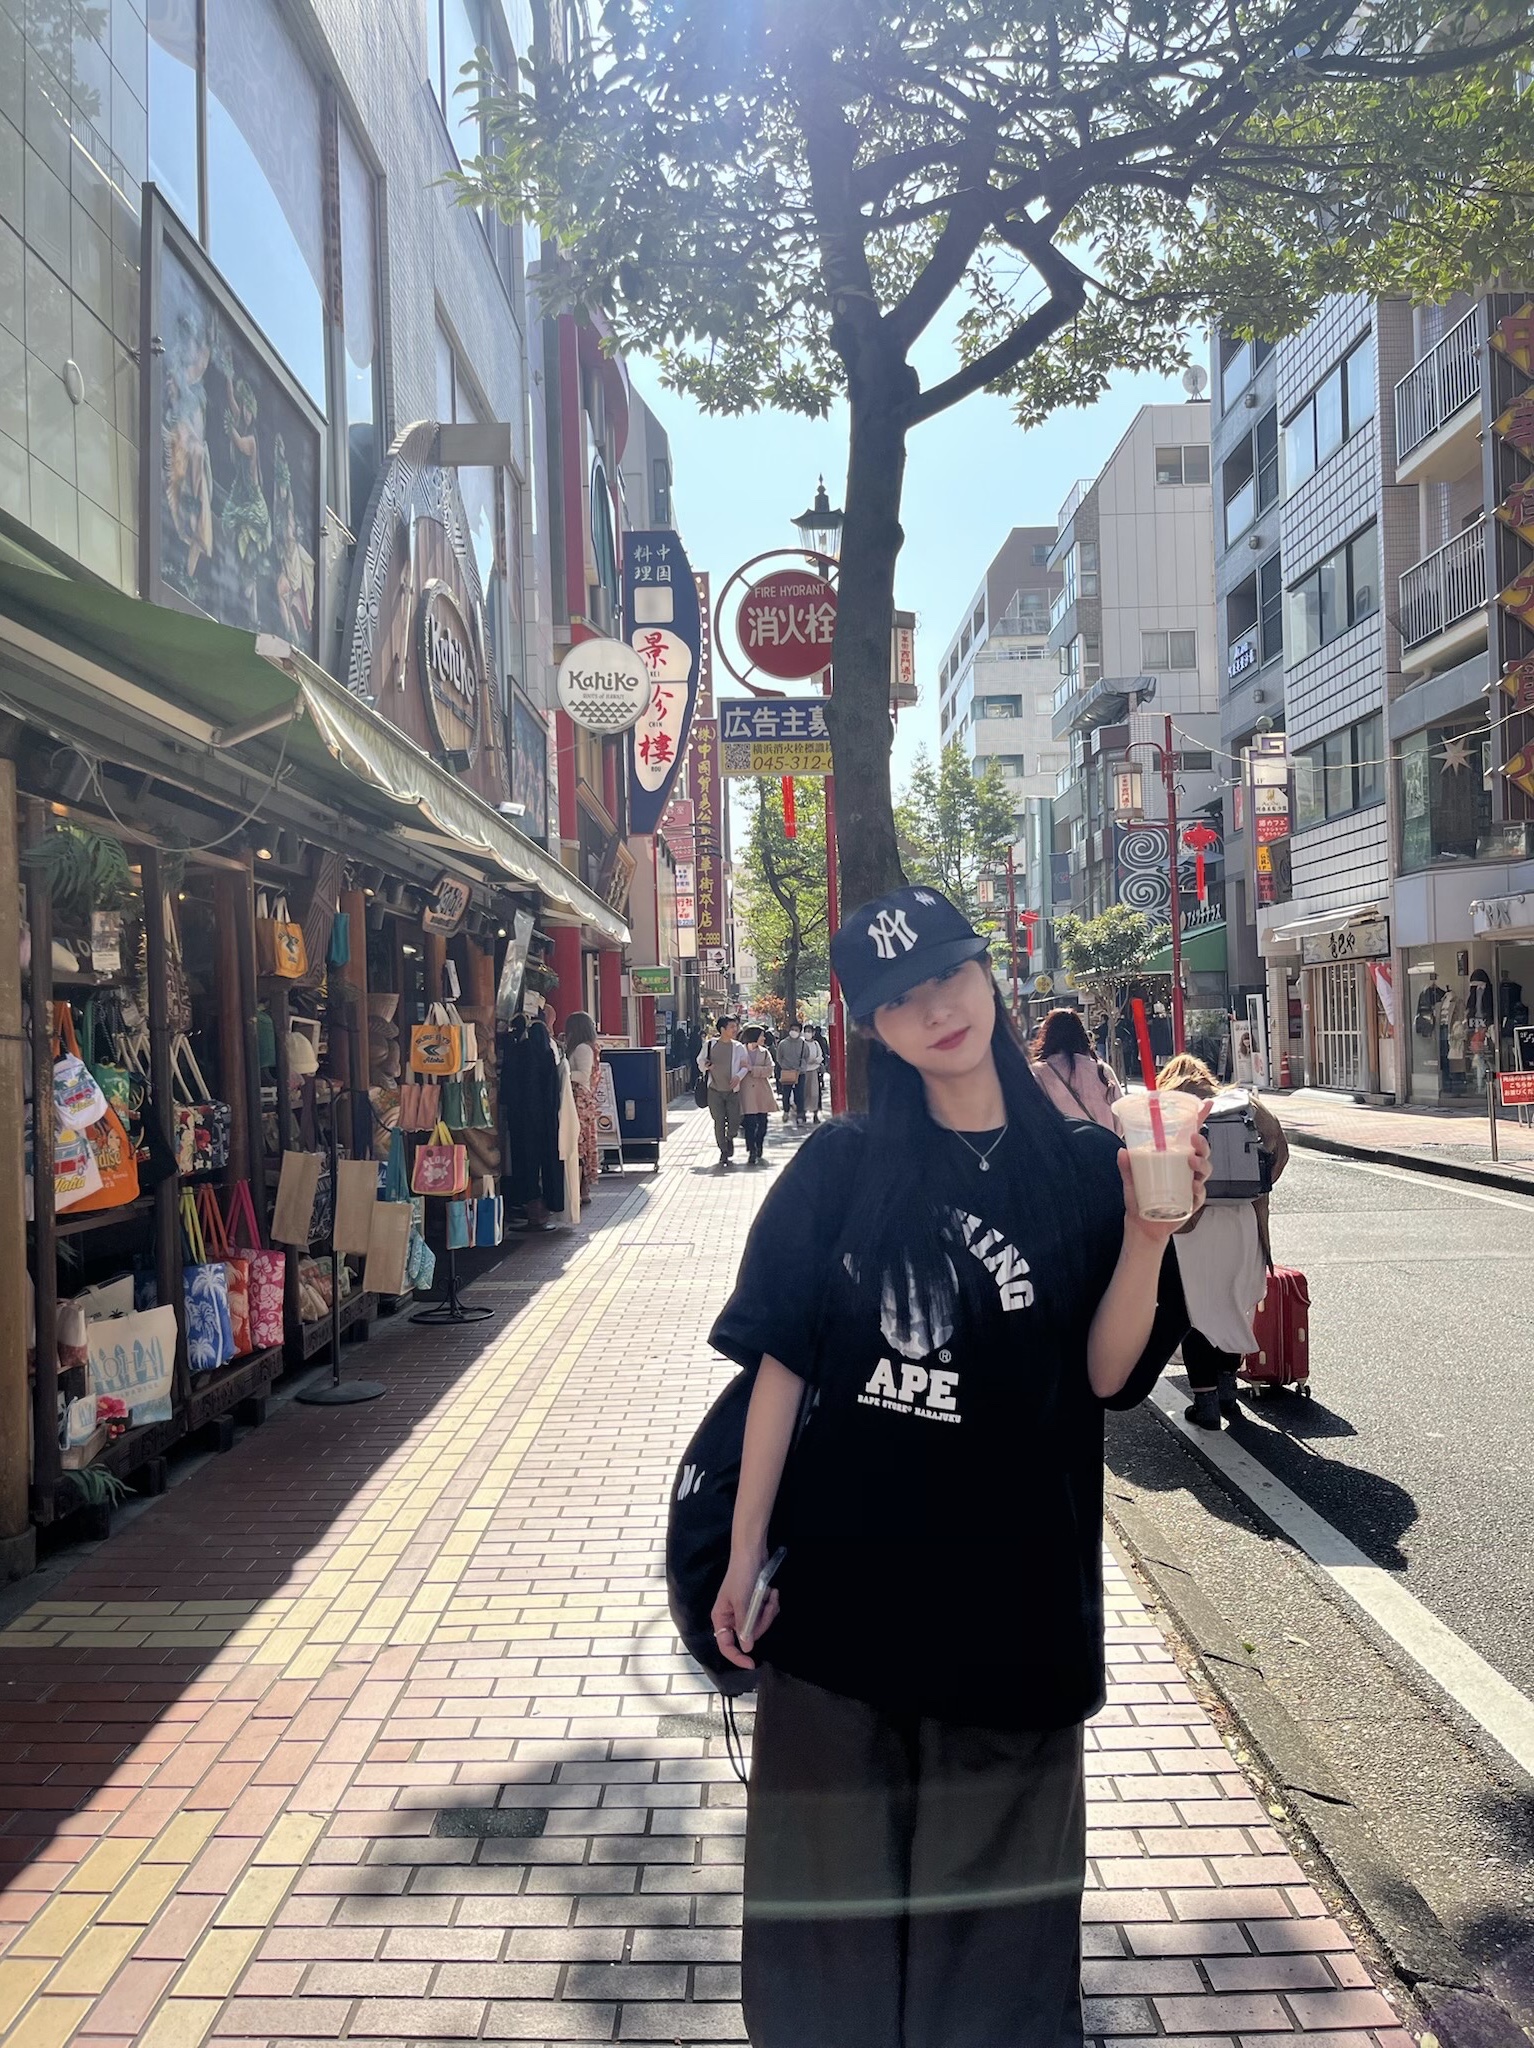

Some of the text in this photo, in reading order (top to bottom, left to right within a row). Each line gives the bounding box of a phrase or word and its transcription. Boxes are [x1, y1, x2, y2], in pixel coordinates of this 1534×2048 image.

[754, 583, 826, 598] FIRE HYDRANT
[747, 601, 837, 648] 消火栓
[865, 1357, 960, 1411] APE
[857, 1394, 881, 1407] BAPE
[914, 1406, 962, 1424] HARAJUKU
